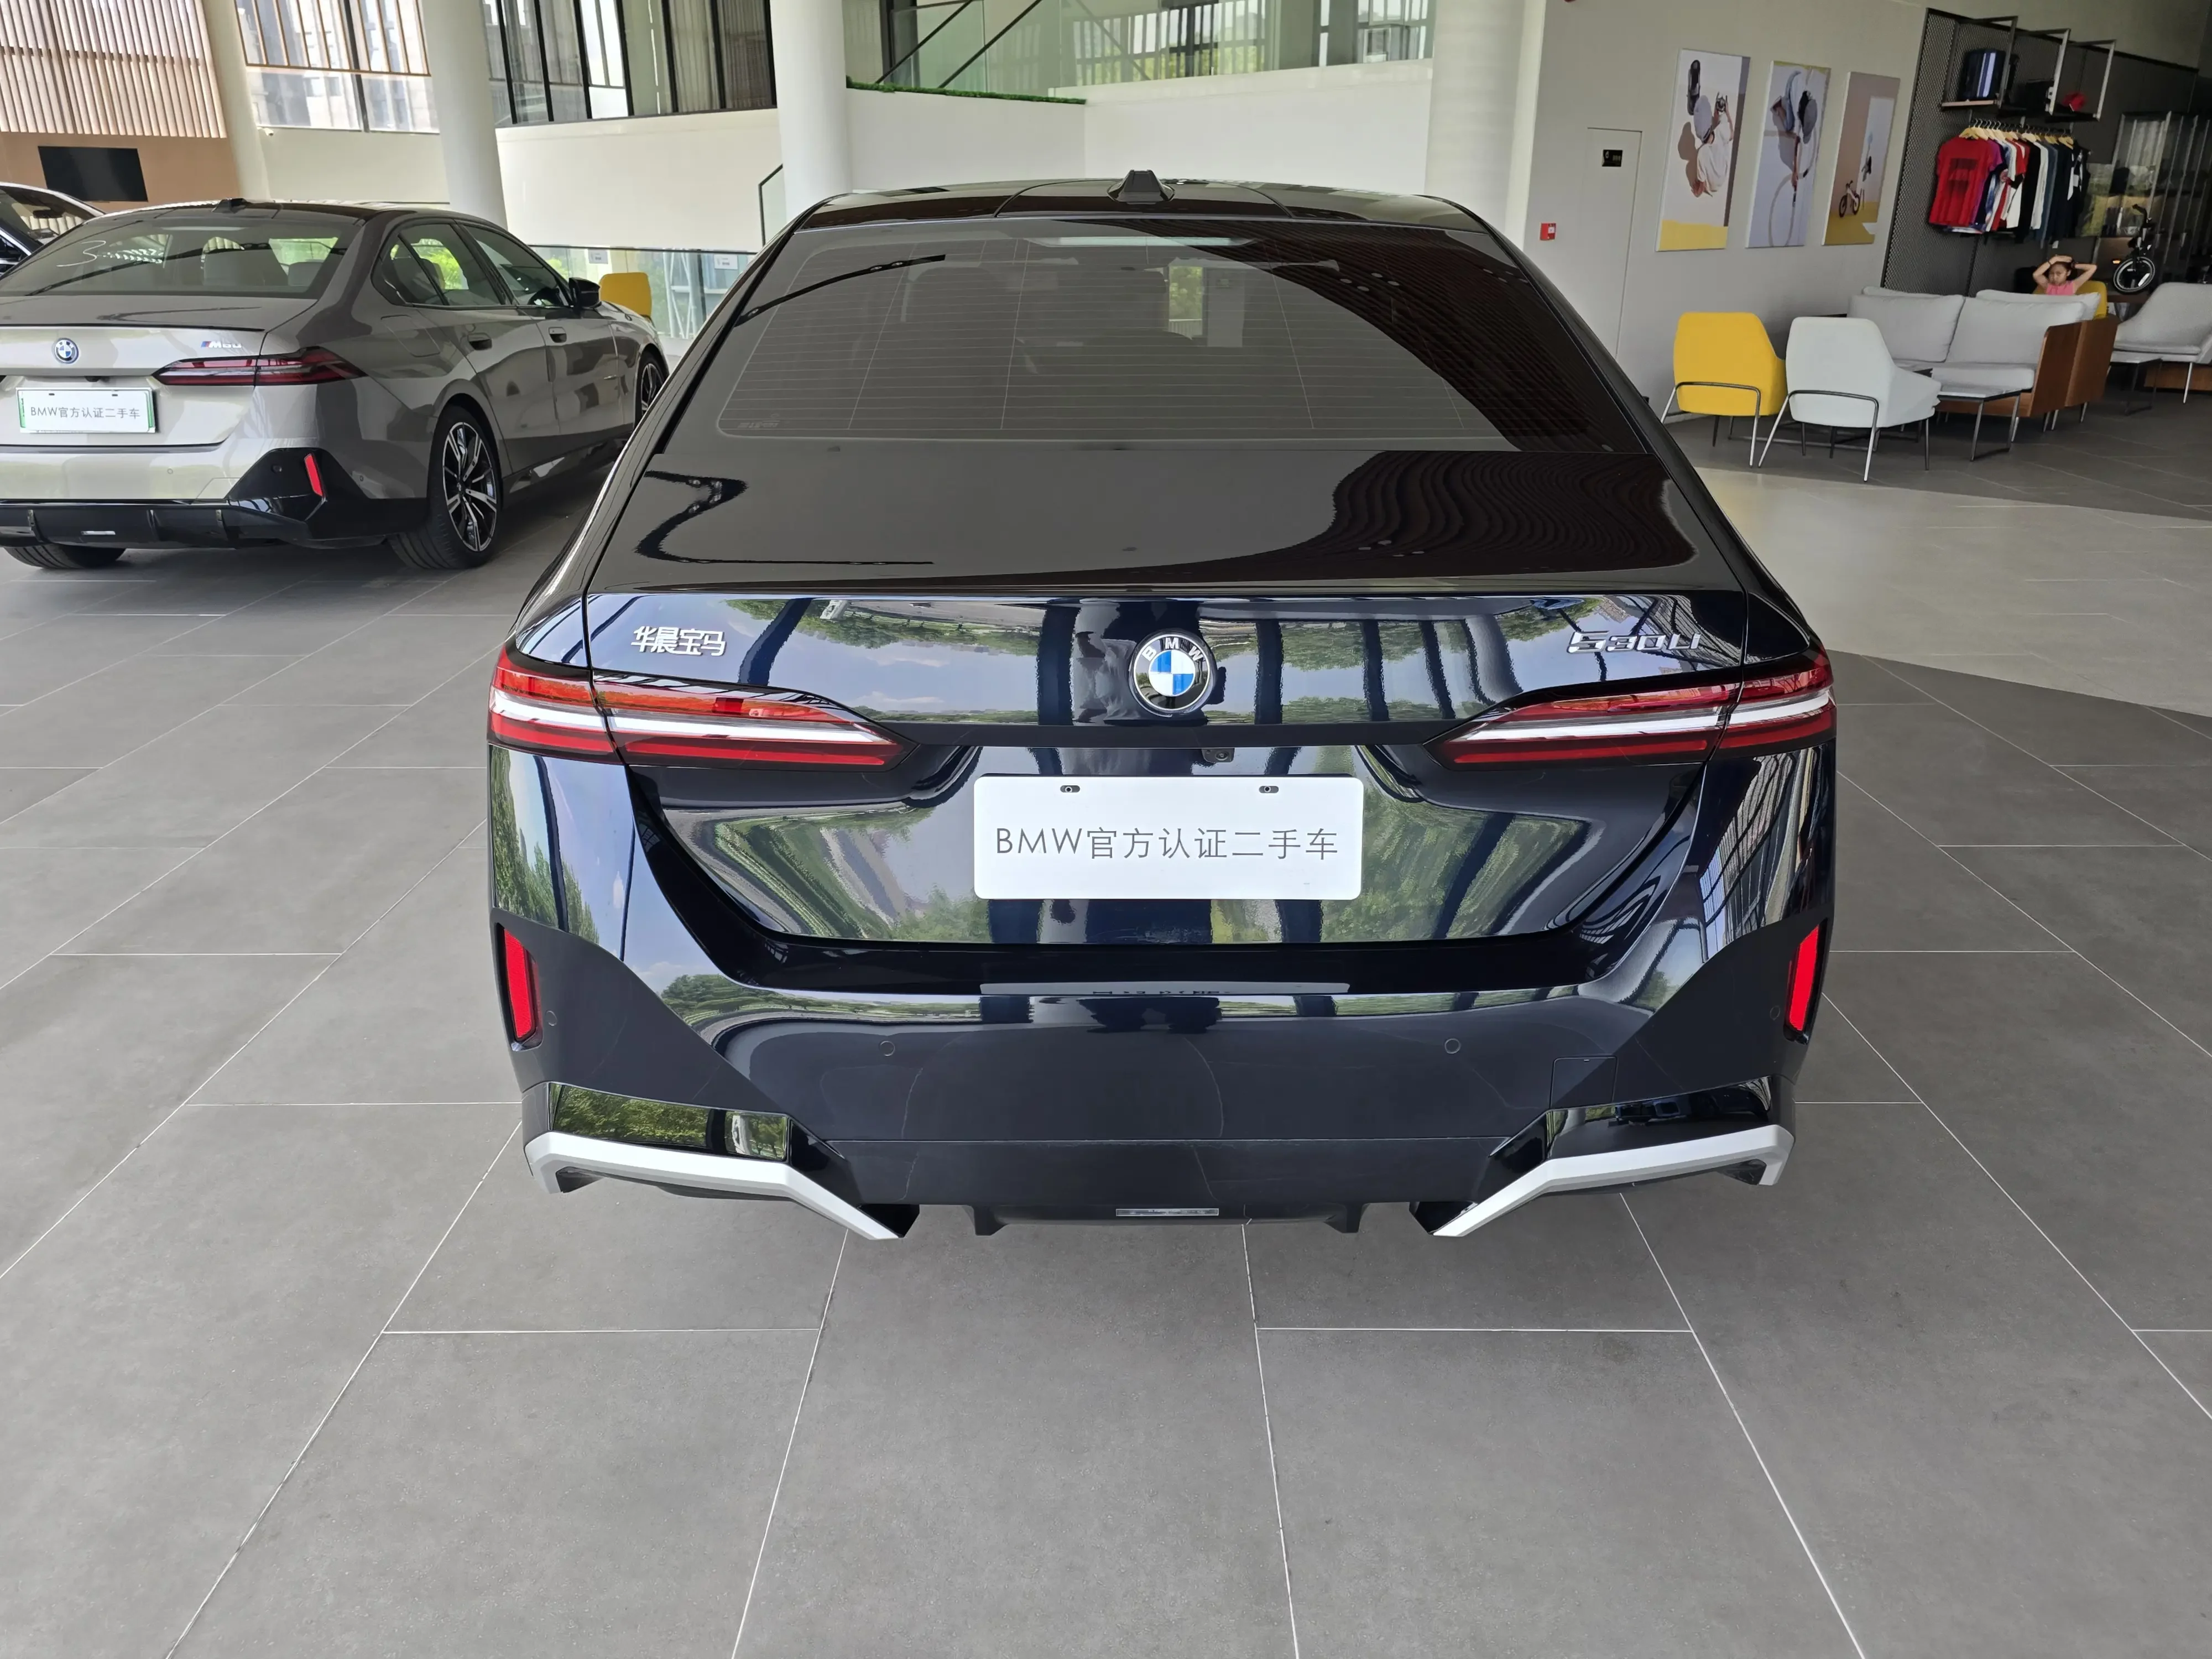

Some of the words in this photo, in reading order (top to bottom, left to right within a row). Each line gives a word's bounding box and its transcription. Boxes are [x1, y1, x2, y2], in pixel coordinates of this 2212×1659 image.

[30, 406, 140, 419] BMW官方认证二手车
[630, 625, 726, 656] 华晨宝马
[1141, 637, 1204, 661] BMW
[1567, 630, 1701, 653] 530Li
[995, 827, 1338, 860] BMW官方认证二手车
